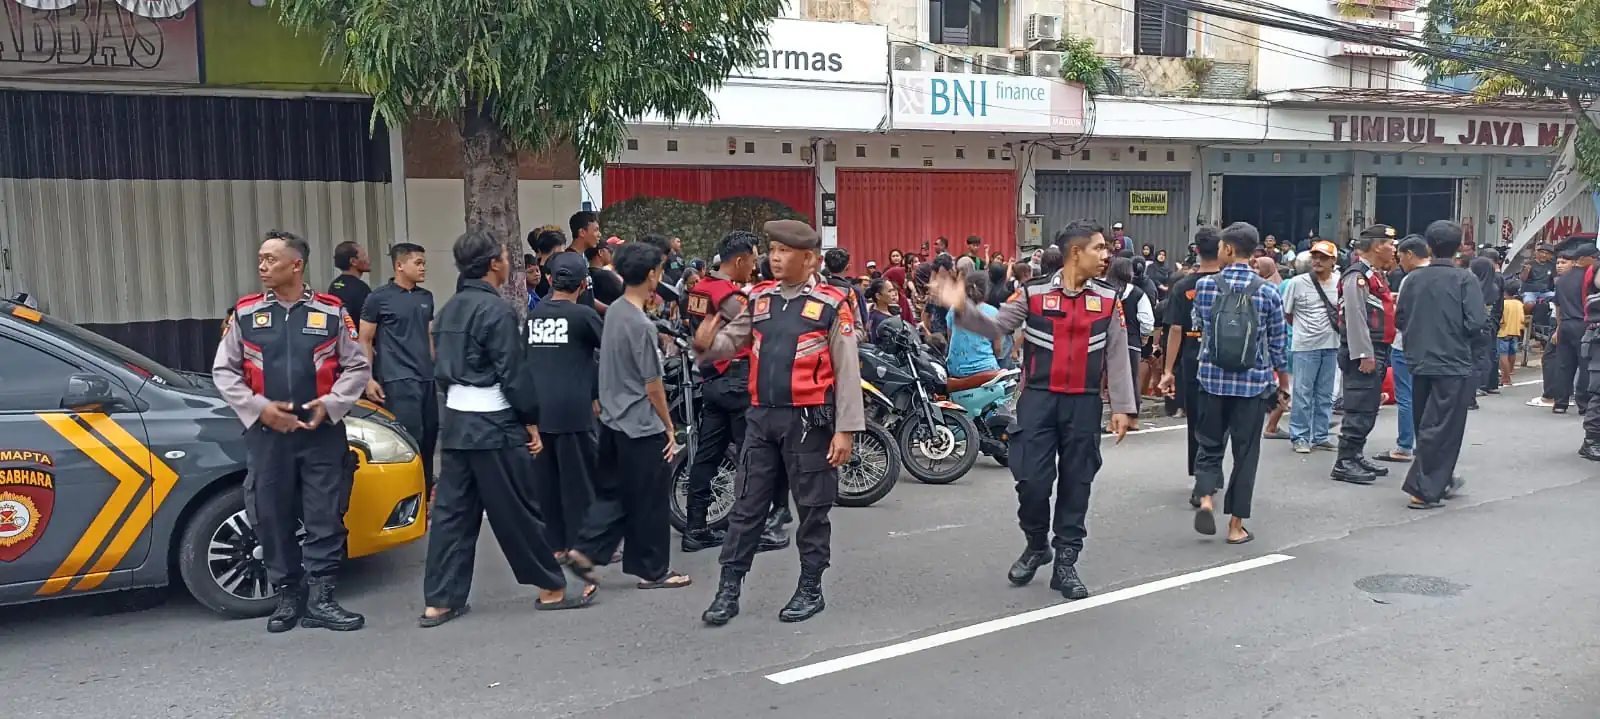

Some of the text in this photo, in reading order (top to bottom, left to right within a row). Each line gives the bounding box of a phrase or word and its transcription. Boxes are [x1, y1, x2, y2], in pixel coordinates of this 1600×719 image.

[930, 78, 1045, 118] BNI finance
[1328, 114, 1445, 144] TIMBUL
[1458, 119, 1525, 147] JAYA
[528, 318, 569, 344] 1922
[0, 451, 52, 465] MAPTA
[0, 469, 53, 489] SABHARA
